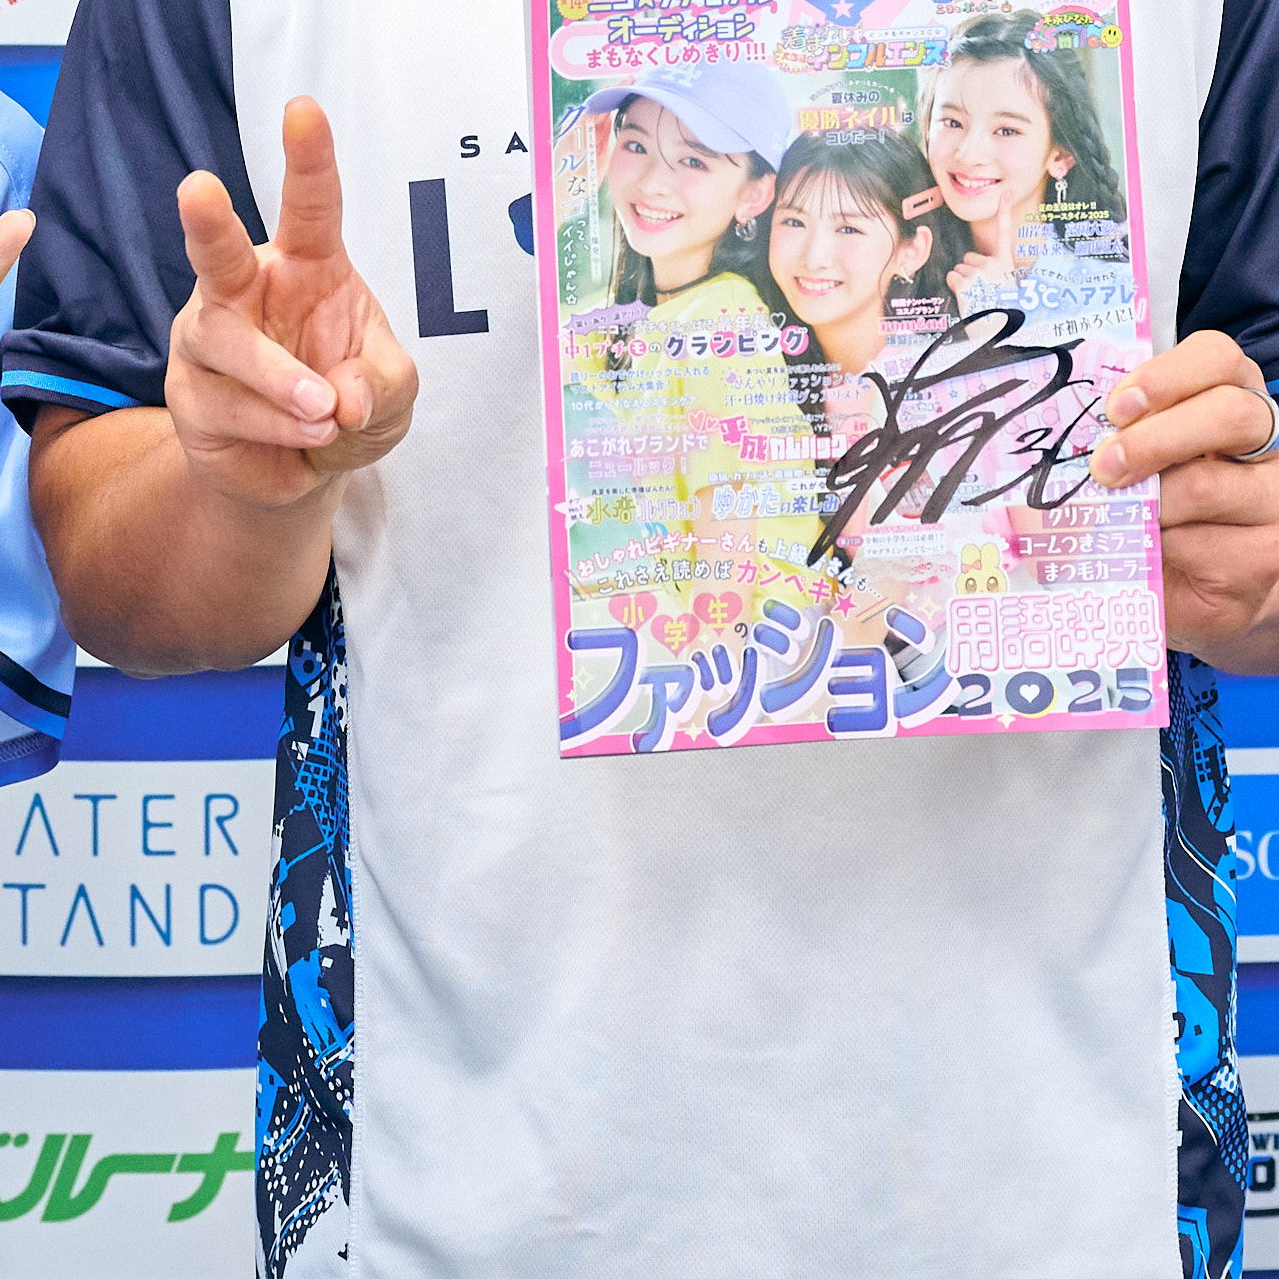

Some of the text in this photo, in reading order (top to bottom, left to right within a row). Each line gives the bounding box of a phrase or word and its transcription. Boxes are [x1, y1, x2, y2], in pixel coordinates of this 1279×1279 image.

[608, 14, 755, 45] オーディション
[948, 590, 1161, 674] 用語辞典
[560, 598, 955, 753] ファッション
